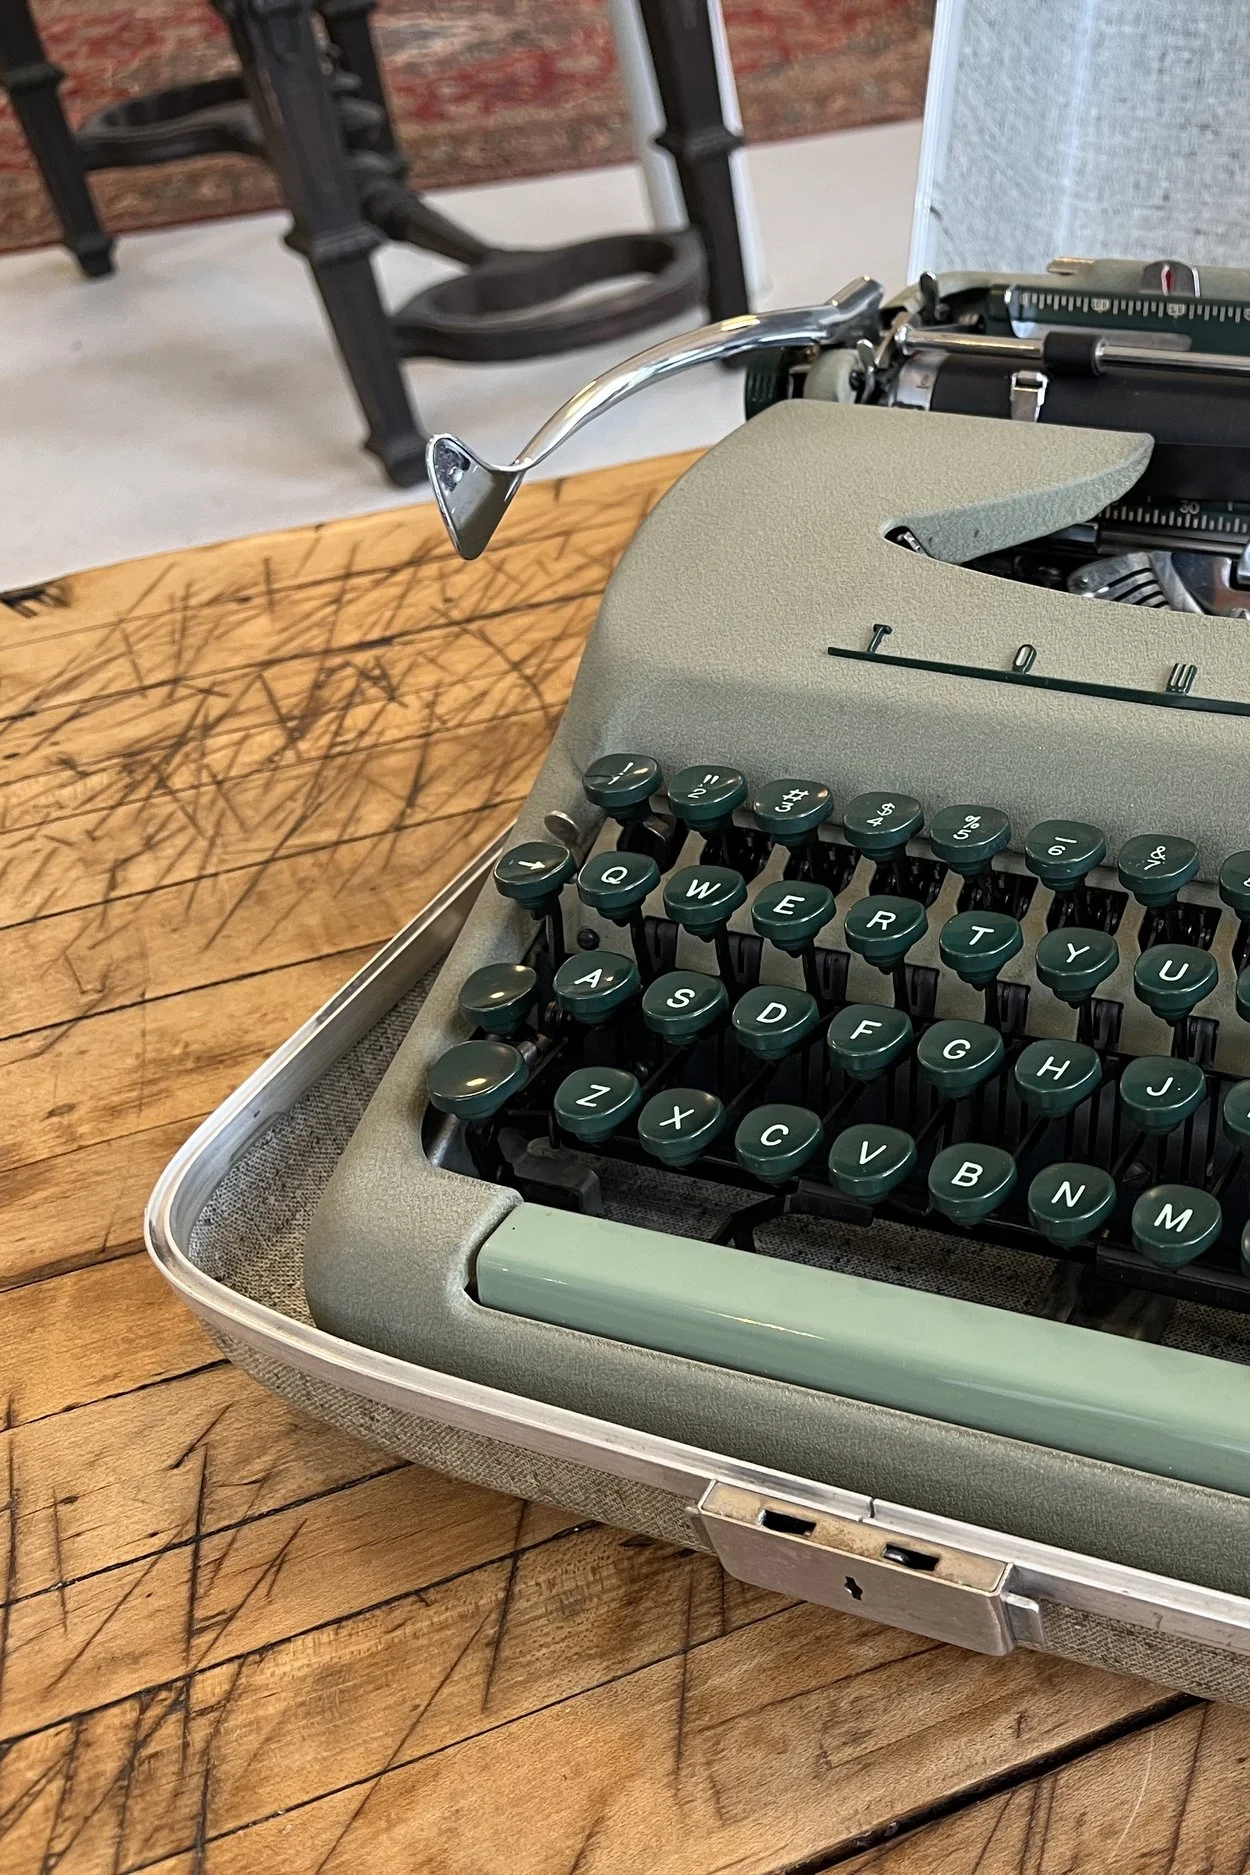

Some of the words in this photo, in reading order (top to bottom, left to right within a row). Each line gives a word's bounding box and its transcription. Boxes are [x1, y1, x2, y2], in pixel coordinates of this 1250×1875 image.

[1180, 500, 1200, 515] 30
[688, 786, 706, 798] 2
[775, 799, 794, 812] 3
[879, 803, 895, 819] $
[867, 814, 883, 826] 4
[953, 827, 971, 839] 5
[1048, 846, 1065, 855] 6
[1144, 858, 1159, 870] 7
[601, 867, 630, 888] Q
[686, 880, 723, 902] W
[773, 895, 805, 914] E
[867, 911, 896, 930] R
[969, 926, 994, 945] T
[1067, 944, 1090, 962] Y
[574, 969, 602, 988] A
[1159, 960, 1189, 981] U
[667, 989, 695, 1008] S
[756, 1003, 787, 1023] D
[850, 1020, 882, 1039] F
[943, 1040, 970, 1059] G
[1037, 1056, 1070, 1080] H
[576, 1085, 610, 1107] Z
[1147, 1077, 1173, 1096] J
[659, 1106, 694, 1129] X
[761, 1125, 788, 1145] C
[860, 1141, 886, 1164] V
[952, 1162, 983, 1186] B
[1051, 1181, 1085, 1207] N
[1154, 1204, 1193, 1232] M
